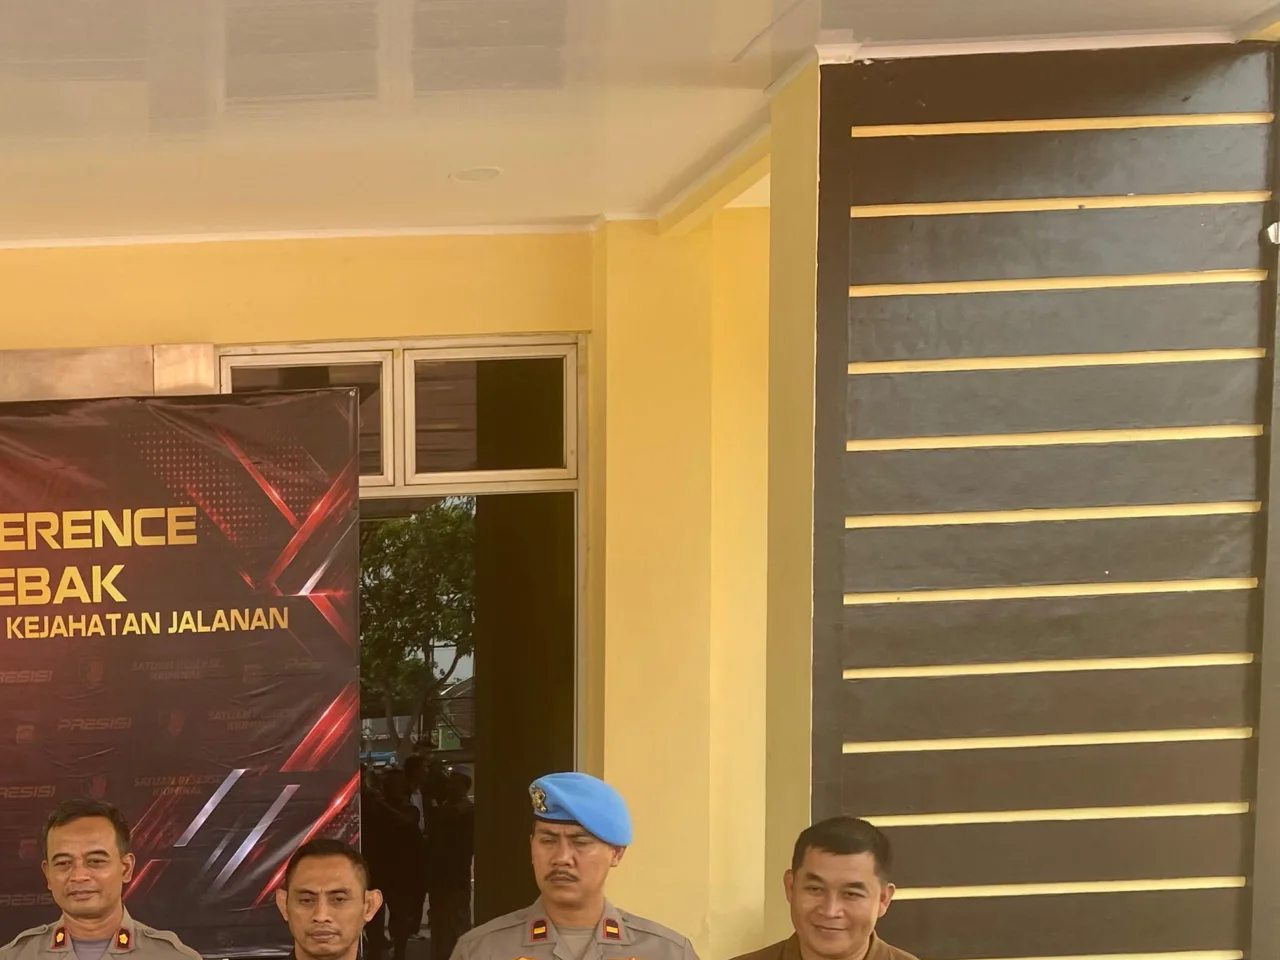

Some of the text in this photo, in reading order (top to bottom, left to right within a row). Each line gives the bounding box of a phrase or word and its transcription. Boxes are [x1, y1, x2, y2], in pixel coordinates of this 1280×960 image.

[6, 612, 161, 640] KEJAHATAN
[167, 606, 288, 634] JALANAN
[57, 717, 132, 731] PRESISI
